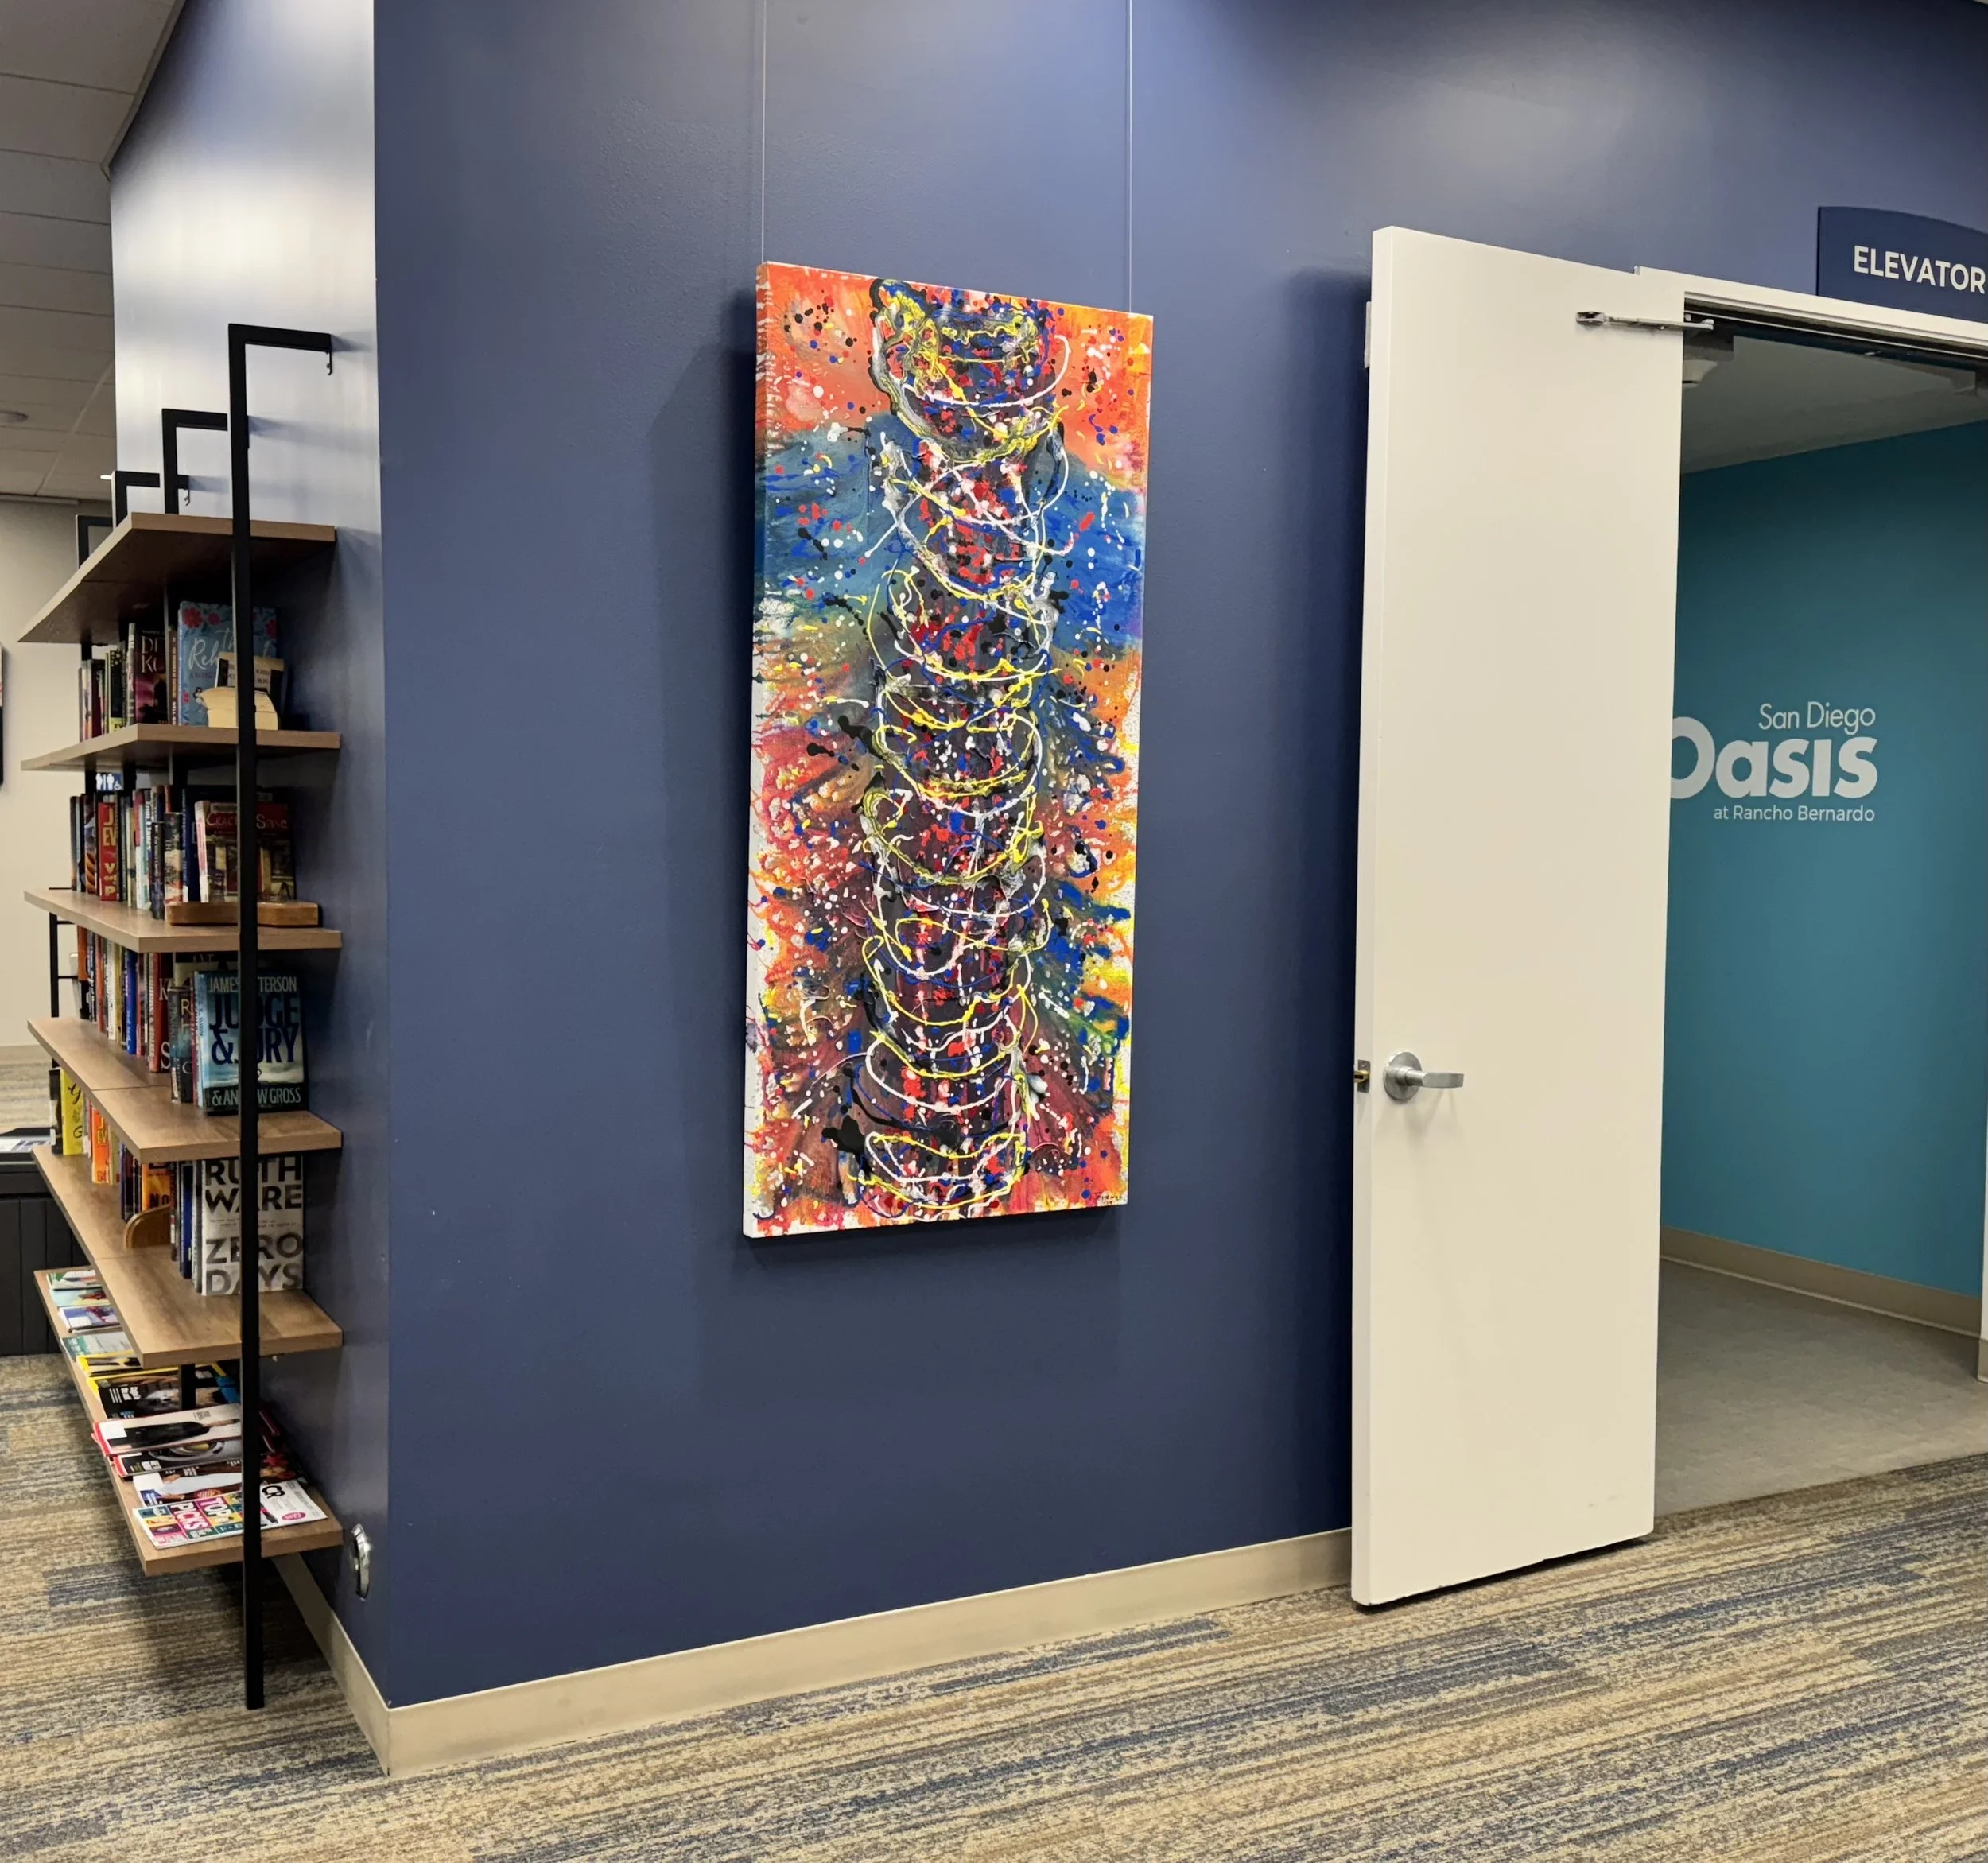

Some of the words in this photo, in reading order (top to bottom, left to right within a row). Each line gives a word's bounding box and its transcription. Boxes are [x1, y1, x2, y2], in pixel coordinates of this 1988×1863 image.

[1854, 245, 1986, 295] ELEVATOR
[1758, 703, 1800, 730] San
[1807, 701, 1877, 736] Diego
[1670, 716, 1878, 799] Oasis
[1714, 807, 1729, 821] at
[1733, 805, 1792, 821] Rancho
[1797, 805, 1875, 822] Bernardo
[257, 976, 297, 992] TERSON
[212, 1090, 222, 1106] &
[223, 1089, 268, 1106] ANW
[270, 1087, 302, 1104] GROSS
[169, 1502, 209, 1530] PICKS
